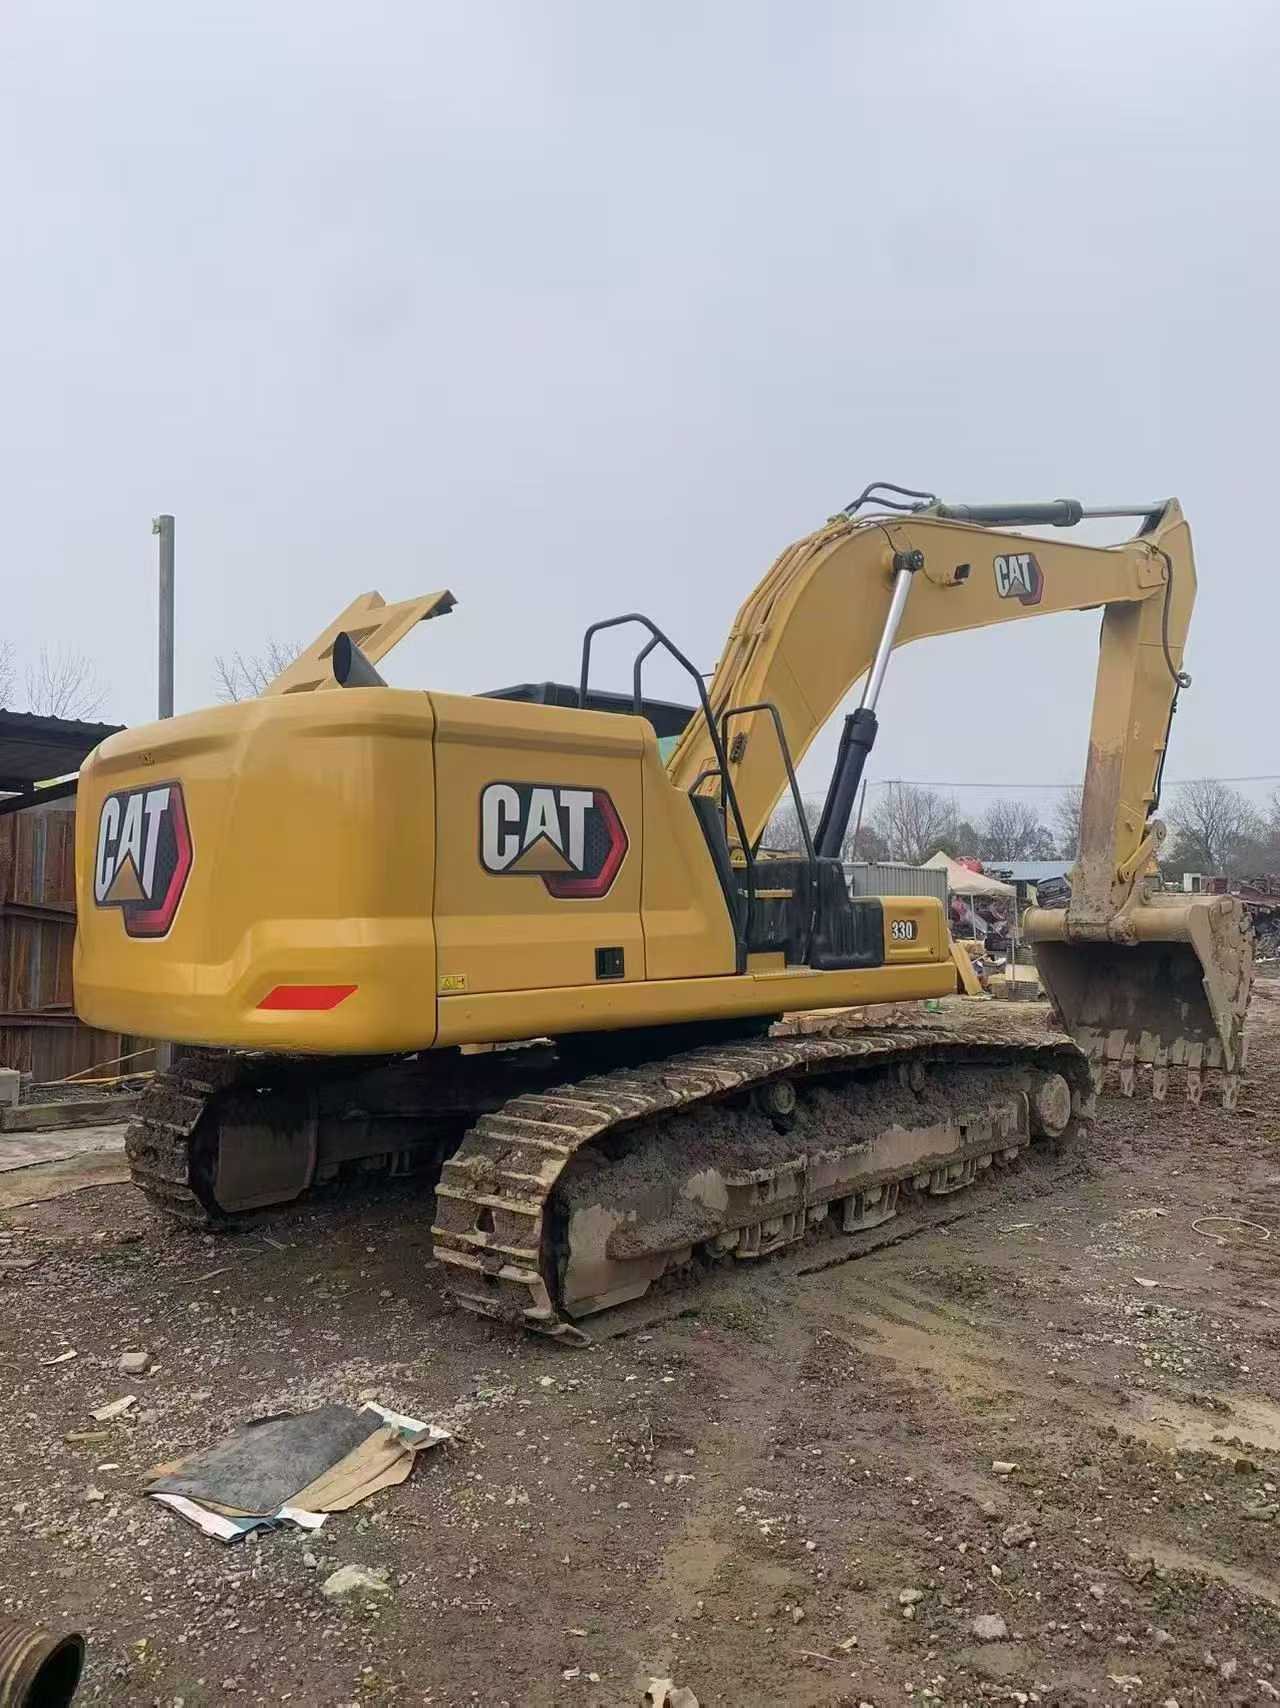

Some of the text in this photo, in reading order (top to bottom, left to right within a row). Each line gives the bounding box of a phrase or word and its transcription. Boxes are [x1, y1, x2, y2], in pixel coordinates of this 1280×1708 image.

[994, 554, 1032, 597] CAT
[97, 787, 170, 901] CAT
[482, 784, 594, 872] CAT
[891, 921, 913, 940] 330
